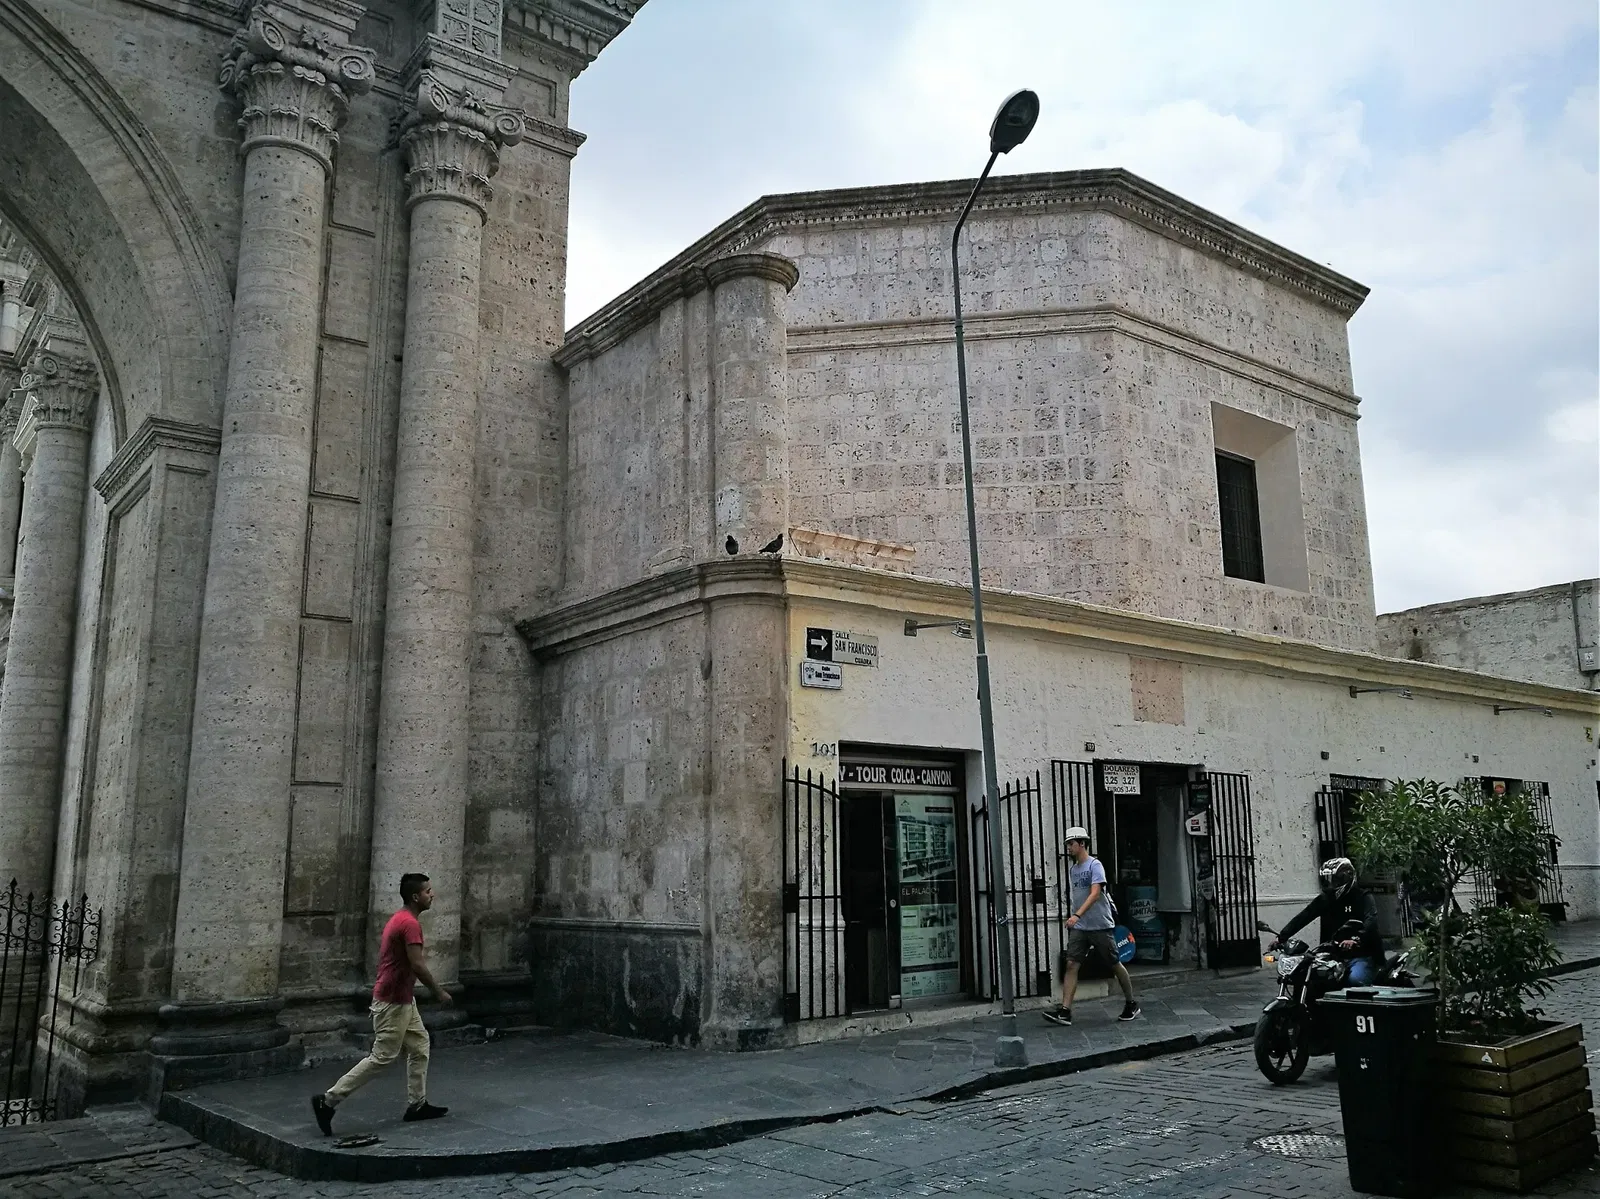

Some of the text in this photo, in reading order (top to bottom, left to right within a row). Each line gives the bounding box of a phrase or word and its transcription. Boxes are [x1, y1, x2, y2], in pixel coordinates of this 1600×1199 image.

[834, 640, 877, 656] SAN FRANCISCO
[854, 657, 872, 665] CUADRA
[812, 742, 838, 757] 101
[856, 766, 887, 783] TOUR
[890, 767, 916, 784] COLCA
[921, 769, 952, 786] CANYON
[1104, 776, 1135, 784] 3.25 3.27
[902, 888, 910, 896] EL
[1356, 1015, 1375, 1034] 91
